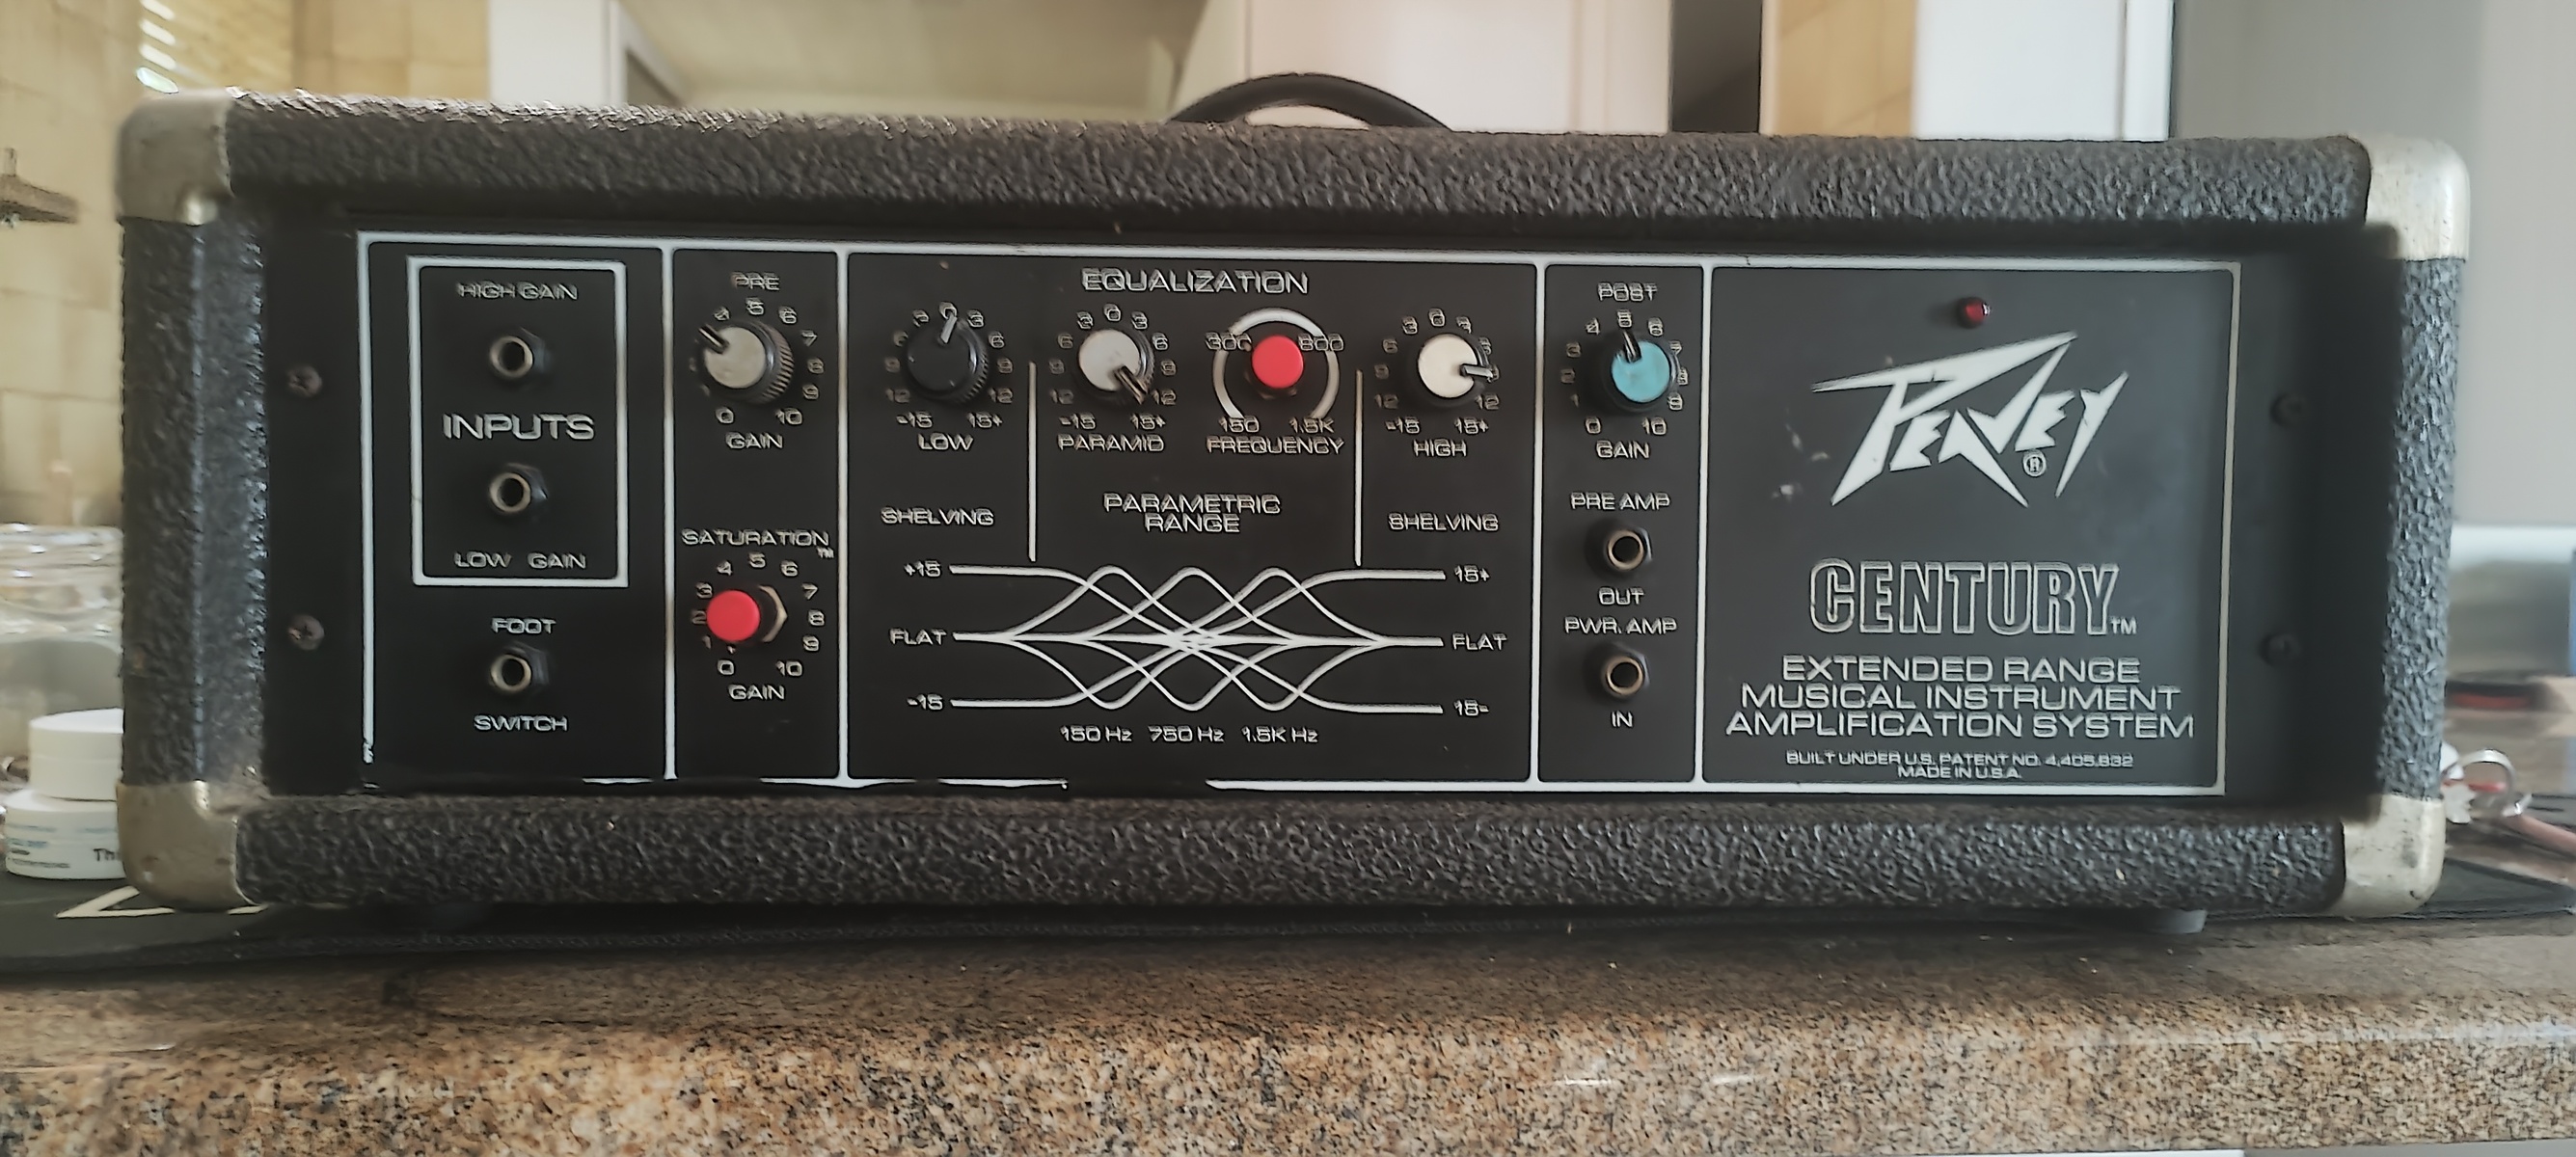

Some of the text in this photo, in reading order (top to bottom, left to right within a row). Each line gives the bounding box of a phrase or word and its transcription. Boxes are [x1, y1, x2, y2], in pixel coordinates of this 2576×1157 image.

[731, 272, 780, 290] PRE
[1081, 268, 1308, 293] EQUALIZATION
[457, 282, 578, 300] HIGH GAIN
[1597, 282, 1658, 302] POST
[746, 297, 764, 315] 5
[778, 306, 797, 324] 6
[1103, 303, 1122, 321] 0
[967, 309, 985, 328] 3
[1076, 310, 1094, 329] 3
[1131, 311, 1149, 330] 3
[1402, 315, 1419, 335] 3
[1428, 308, 1446, 327] 0
[1586, 317, 1601, 335] 4
[1647, 317, 1664, 336] 6
[800, 330, 817, 346] 7
[988, 331, 1005, 348] 6
[1152, 332, 1169, 350] 6
[1206, 332, 1252, 351] 300
[1298, 333, 1344, 351] 800
[803, 384, 819, 400] 9
[988, 388, 1013, 403] 12
[1049, 389, 1073, 404] 12
[1152, 389, 1176, 405] 12
[1475, 393, 1500, 410] 12
[716, 407, 734, 424] 0
[775, 408, 802, 425] 10
[1218, 416, 1260, 433] 150
[1811, 330, 2129, 507] PEAVEY
[444, 414, 595, 441] INPUTS
[1288, 417, 1335, 434] 1.5K
[1586, 417, 1602, 434] 0
[1641, 417, 1668, 435] 10
[725, 431, 783, 449] GAIN
[918, 433, 974, 450] LOW
[1058, 434, 1165, 452] PARAMID
[1207, 436, 1344, 454] FREQUENCY
[1413, 438, 1467, 457] HIGH
[1596, 440, 1651, 459] GAIN
[1103, 492, 1281, 515] PARAMETRIC
[1570, 492, 1670, 510] PRE AMP
[881, 507, 994, 525] SHELVING
[1145, 512, 1241, 534] RANGE
[1389, 513, 1499, 531] SHELVING
[682, 528, 828, 546] SATURATION
[454, 552, 586, 569] LOW GAIN
[717, 560, 733, 576] 4
[748, 552, 766, 568] 5
[781, 560, 799, 577] 6
[904, 560, 941, 578] +15
[1453, 564, 1490, 582] 15+
[695, 582, 713, 599] 3
[801, 582, 819, 600] 7
[1599, 587, 1644, 605] OUT
[1809, 557, 2137, 635] CENTURY TM
[492, 617, 556, 633] FOOT
[691, 609, 708, 625] 2
[808, 609, 825, 627] 8
[1564, 616, 1677, 634] PWR. AMP
[802, 634, 820, 652] 9
[889, 629, 947, 645] FLAT
[1451, 632, 1507, 650] FLAT
[717, 659, 735, 676] 0
[775, 660, 803, 677] 10
[1782, 655, 2141, 685] EXTENDED RANGE
[728, 685, 785, 700] GAIN
[1741, 683, 2182, 712] MUSICAL INSTRUMENT
[907, 693, 943, 711] -15
[1453, 699, 1490, 716] 15-
[475, 715, 567, 732] SWITCH
[1612, 711, 1633, 728] IN
[1726, 710, 2195, 740] AMPLIFICATION SYSTEM
[1060, 725, 1132, 742] 150 Hz
[1148, 725, 1225, 742] 750 Hz
[1241, 725, 1318, 743] 1.5K Hz
[1786, 750, 1835, 765] BUILT
[1838, 751, 1901, 766] UNDER
[1939, 751, 2009, 767] PATENT
[1897, 765, 1952, 779] MADE
[1954, 766, 1972, 779] IN
